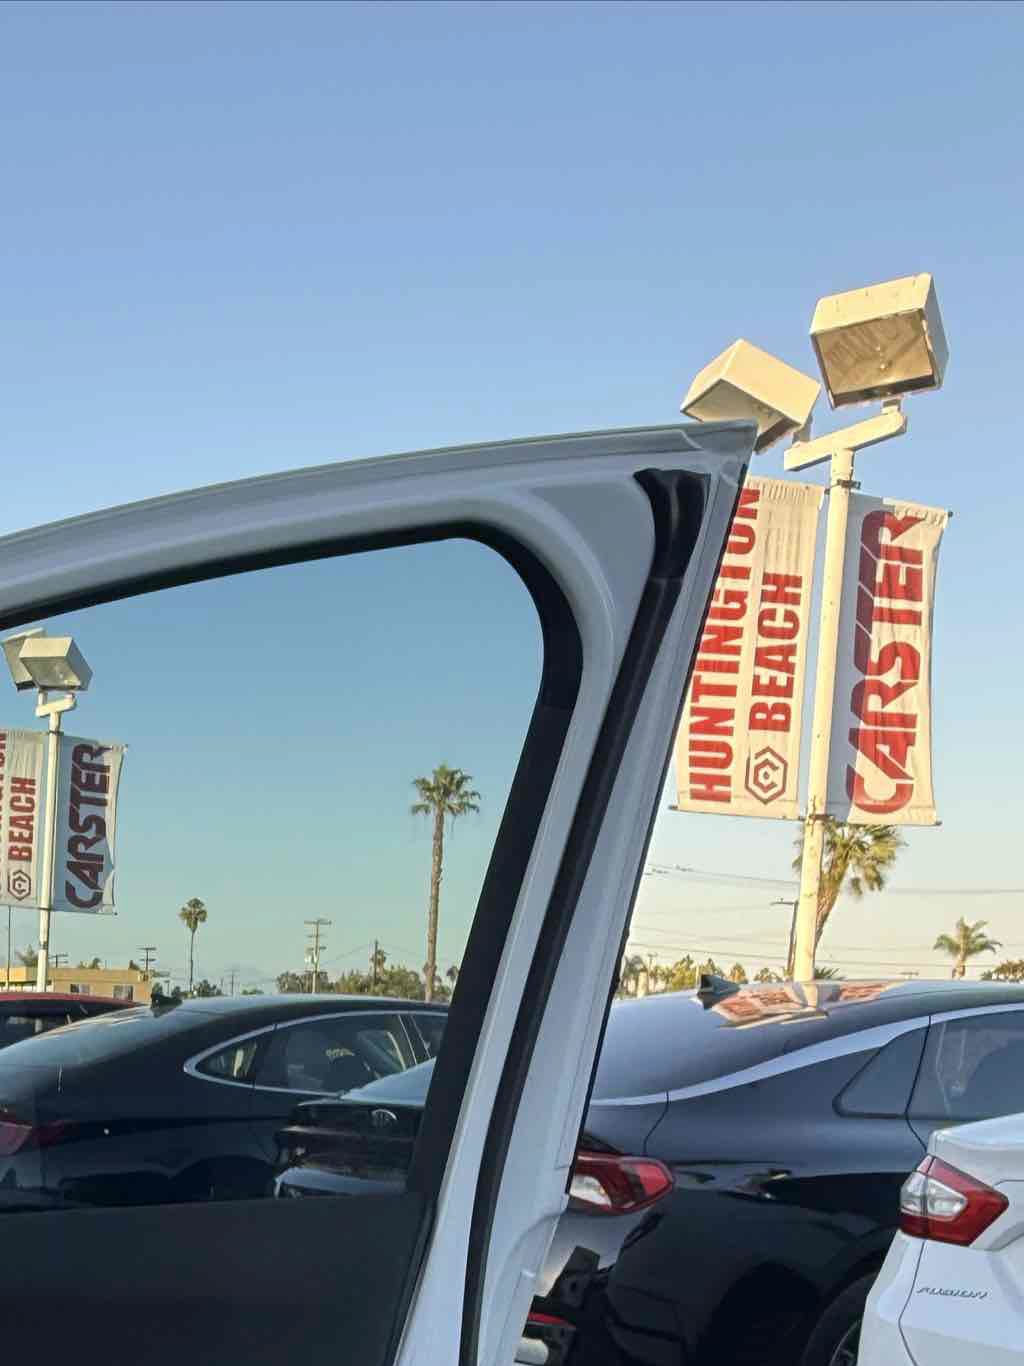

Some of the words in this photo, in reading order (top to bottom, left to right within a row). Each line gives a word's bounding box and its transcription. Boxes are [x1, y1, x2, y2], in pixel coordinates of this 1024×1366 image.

[748, 572, 803, 733] BEACH
[846, 508, 926, 815] CARSTER
[8, 776, 36, 862] BEACH
[65, 743, 112, 908] CARSTER
